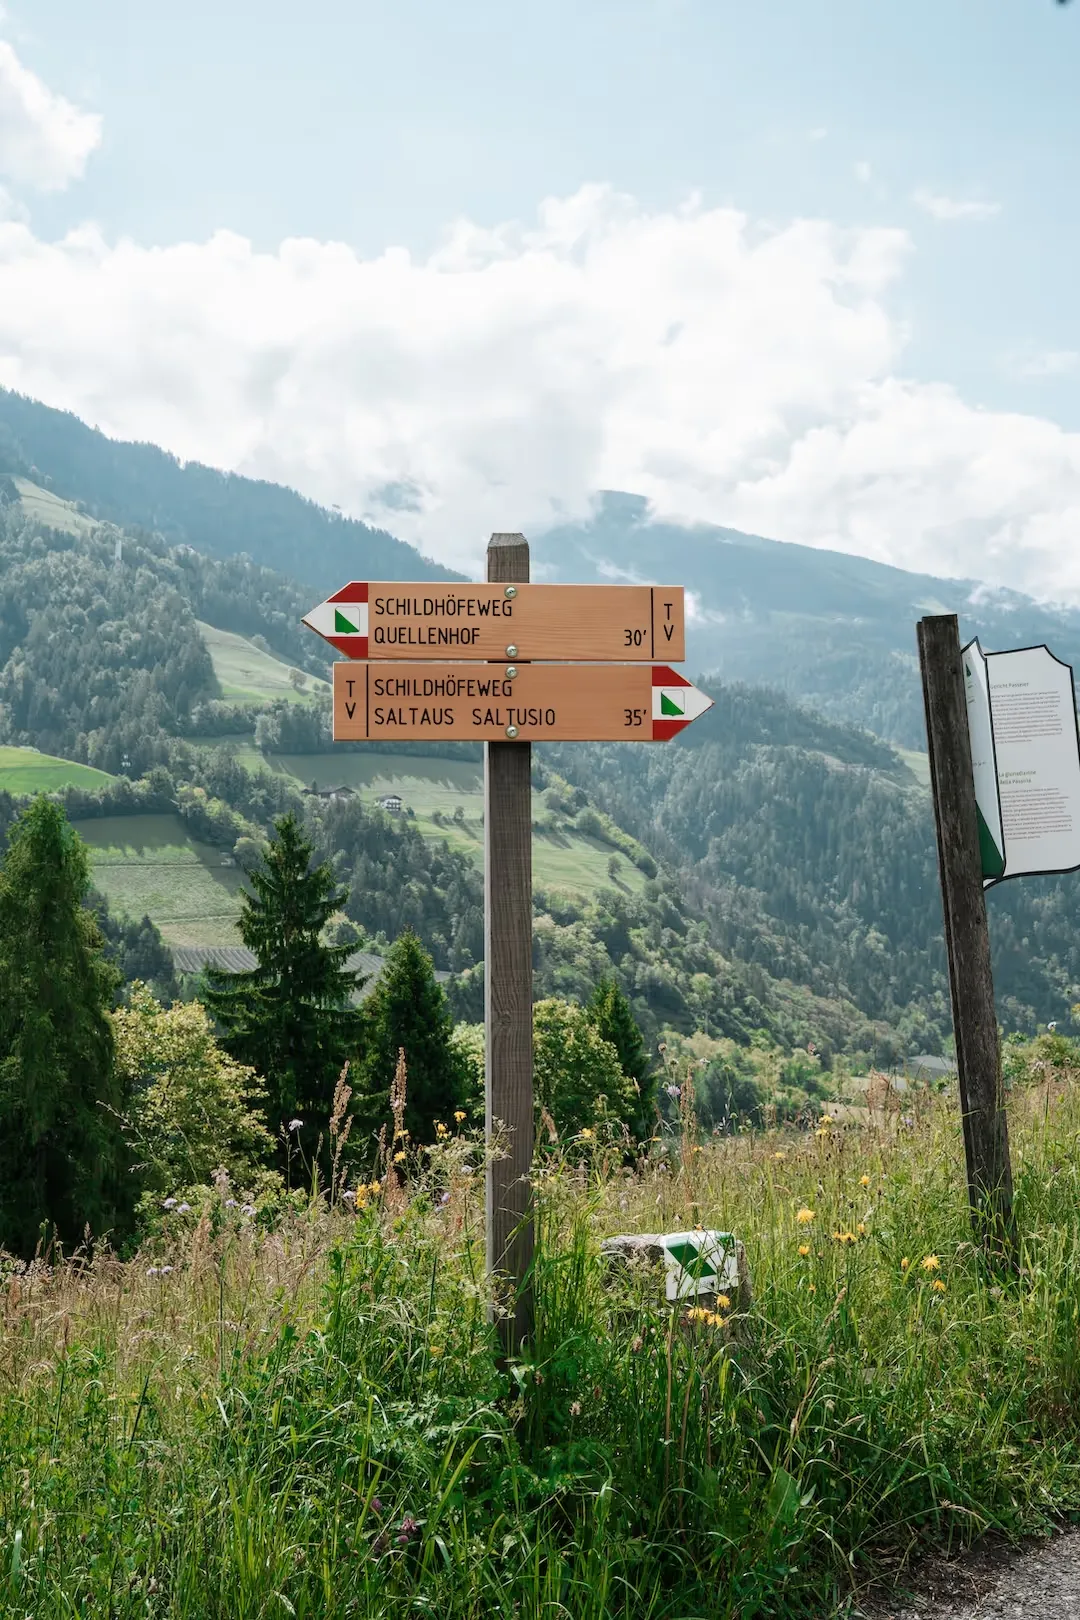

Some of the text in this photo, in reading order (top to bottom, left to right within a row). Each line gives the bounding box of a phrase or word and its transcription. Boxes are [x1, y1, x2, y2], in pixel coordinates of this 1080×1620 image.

[374, 594, 513, 617] SCHILDHÖFEWEG
[663, 603, 674, 621] T
[374, 626, 647, 647] QUELLENHOF 30'
[663, 624, 674, 642] V
[345, 680, 357, 698] T
[373, 675, 513, 697] SCHILDHÖFEWEG
[344, 702, 357, 720] V
[374, 708, 647, 727] SALTAUS SALTUSIO 35'
